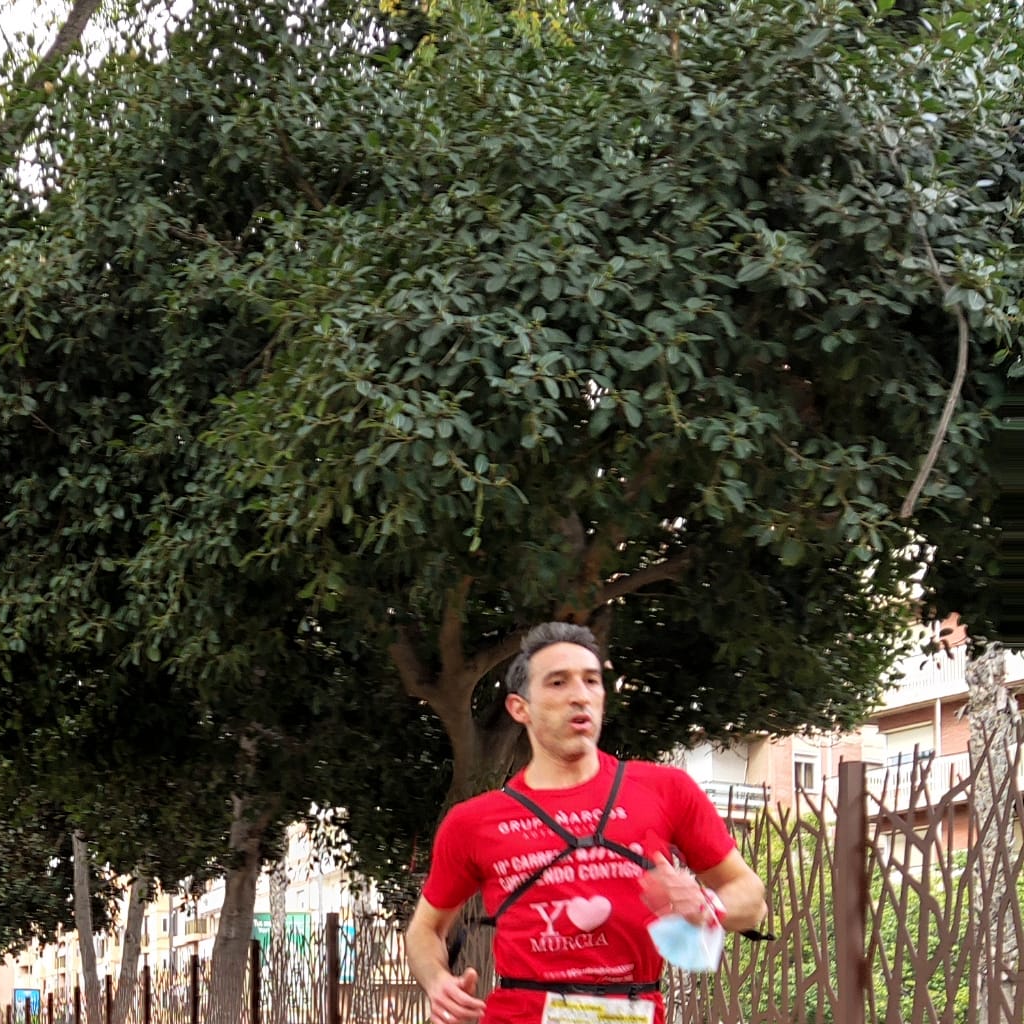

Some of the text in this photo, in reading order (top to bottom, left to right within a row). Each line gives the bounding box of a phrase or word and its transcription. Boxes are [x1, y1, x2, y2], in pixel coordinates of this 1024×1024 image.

[497, 816, 544, 835] GRUP
[529, 899, 570, 937] Y
[529, 932, 609, 953] MURCIA
